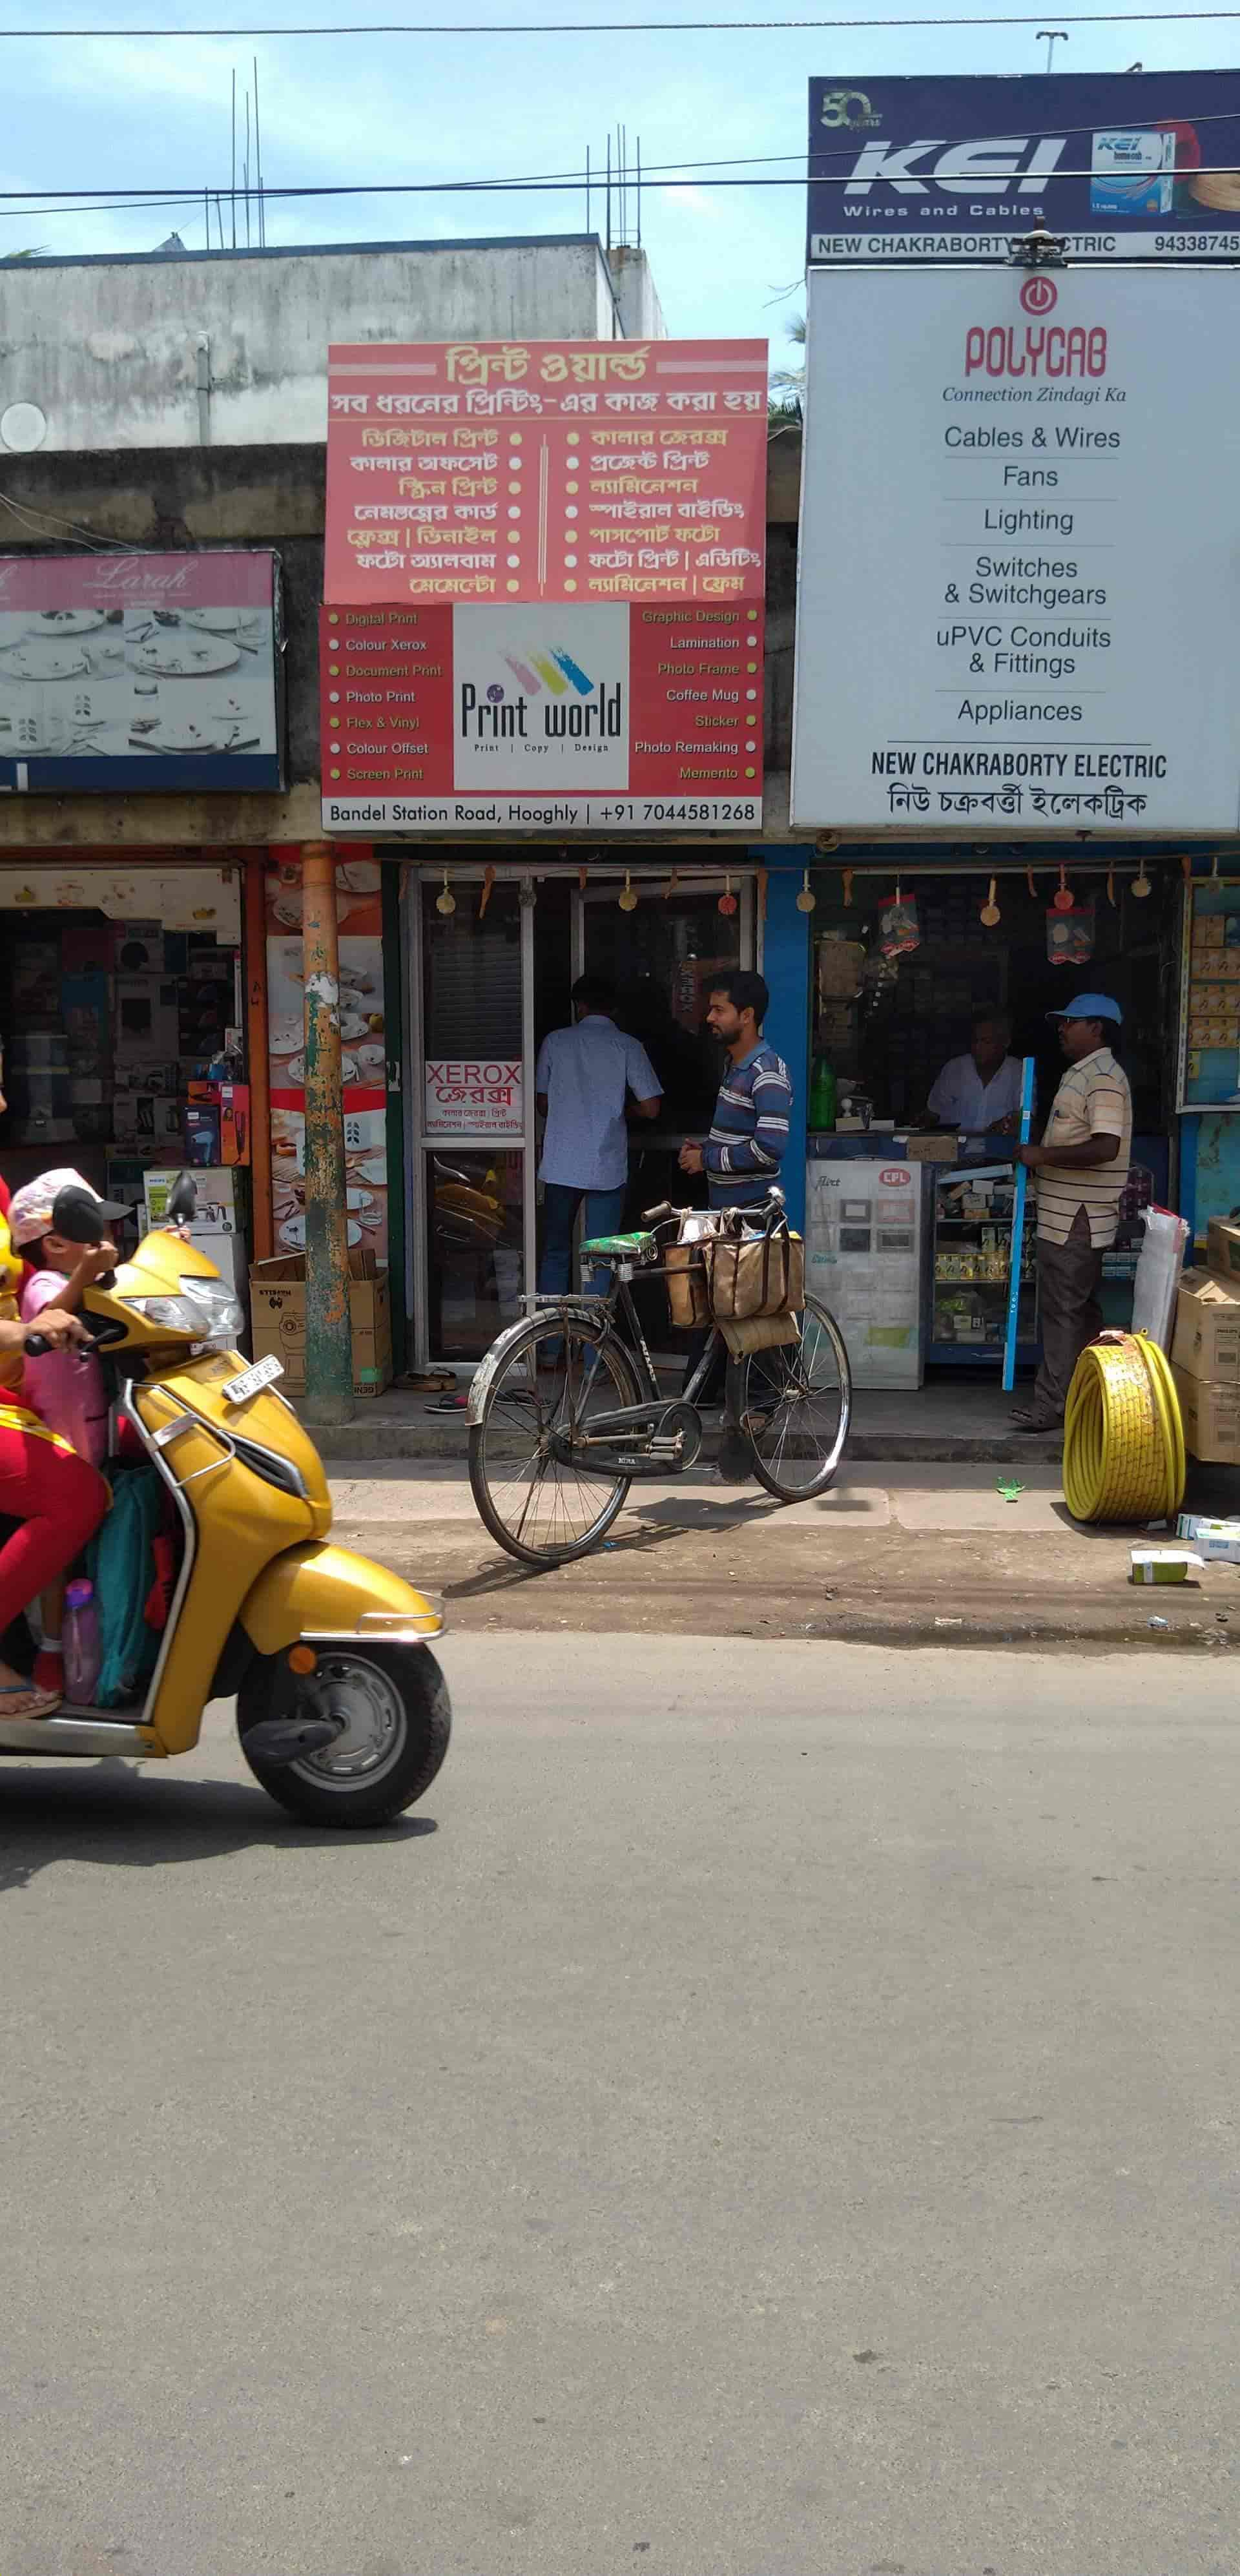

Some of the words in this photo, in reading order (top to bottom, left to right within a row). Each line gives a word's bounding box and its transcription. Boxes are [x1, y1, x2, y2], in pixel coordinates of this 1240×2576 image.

[843, 139, 1067, 194] KEI
[843, 205, 908, 216] Wires
[920, 205, 958, 216] and
[969, 204, 1043, 216] Cables
[818, 238, 865, 253] NEW
[868, 236, 1018, 253] CHAKRABORTY
[1027, 236, 1116, 251] CTRIC
[1155, 235, 1239, 251] 94338745
[965, 326, 1107, 377] POLYCAB
[446, 345, 531, 386] প্রিন্ট
[331, 395, 370, 413] সব
[377, 393, 460, 414] ধরনের
[604, 393, 661, 411] কাজ
[666, 392, 718, 411] করা
[942, 387, 1033, 402] Connection
[1037, 387, 1100, 405] Zindagi
[1104, 388, 1126, 402] Ka
[453, 428, 499, 448] প্রিন্ট
[590, 430, 655, 446] কালার
[944, 426, 1023, 448] Cables
[1032, 427, 1048, 448] &
[1055, 426, 1121, 448] Wires
[350, 456, 413, 472] কালার
[663, 450, 710, 470] প্রিন্ট
[1004, 466, 1059, 486] Fans
[452, 477, 497, 497] প্রিন্ট
[984, 509, 1073, 535] Lighting
[674, 525, 720, 543] ফটো
[356, 550, 406, 568] ফটো
[588, 550, 634, 568] ফটো
[638, 549, 679, 569] প্রিন্ট
[976, 557, 1078, 577] Switches
[944, 584, 960, 603] &
[969, 583, 1107, 608] Switchgears
[346, 612, 385, 625] Digital
[389, 612, 418, 624] Print
[642, 610, 692, 625] Graphic
[696, 610, 739, 624] Design
[346, 639, 388, 650] Colour
[391, 639, 427, 650] Xerox
[670, 636, 739, 649] Lamination
[936, 626, 1002, 647] uPVC
[1010, 626, 1111, 648] Conduits
[346, 665, 409, 677] Document
[413, 665, 442, 676] Print
[658, 663, 695, 674] Photo
[699, 663, 739, 674] Frame
[969, 654, 985, 672] &
[994, 653, 1075, 678] Fittings
[346, 691, 382, 703] Photo
[387, 691, 416, 703] Print
[666, 689, 710, 701] Coffee
[712, 689, 739, 703] Mug
[462, 683, 528, 736] Print
[544, 683, 621, 736] world
[958, 700, 1082, 725] Appliances
[347, 717, 373, 729] Flex
[377, 718, 386, 729] &
[389, 717, 419, 731] Vinyl
[695, 715, 739, 727] Sticker
[347, 743, 388, 754] Colour
[391, 742, 429, 754] Offset
[475, 743, 499, 752] Print
[524, 743, 549, 754] Copy
[574, 743, 609, 754] Design
[634, 742, 671, 753] Photo
[674, 742, 739, 755] Remaking
[347, 768, 390, 780] Screen
[394, 768, 424, 780] Print
[680, 767, 738, 779] Memento
[872, 752, 916, 774] NEW
[923, 752, 1068, 776] CHAKRABORTY
[1074, 754, 1166, 778] ELECTRIC
[887, 782, 931, 813] নিউ
[1029, 784, 1148, 820] ইলেকট্রিক
[330, 805, 386, 822] Bandel
[392, 805, 448, 822] Station
[455, 805, 502, 824] Road,
[508, 805, 577, 824] Hooghly
[600, 805, 634, 821] +91
[643, 804, 755, 820] 7044581268
[427, 1065, 521, 1085] XEROX
[435, 1086, 513, 1106] জেরক্স
